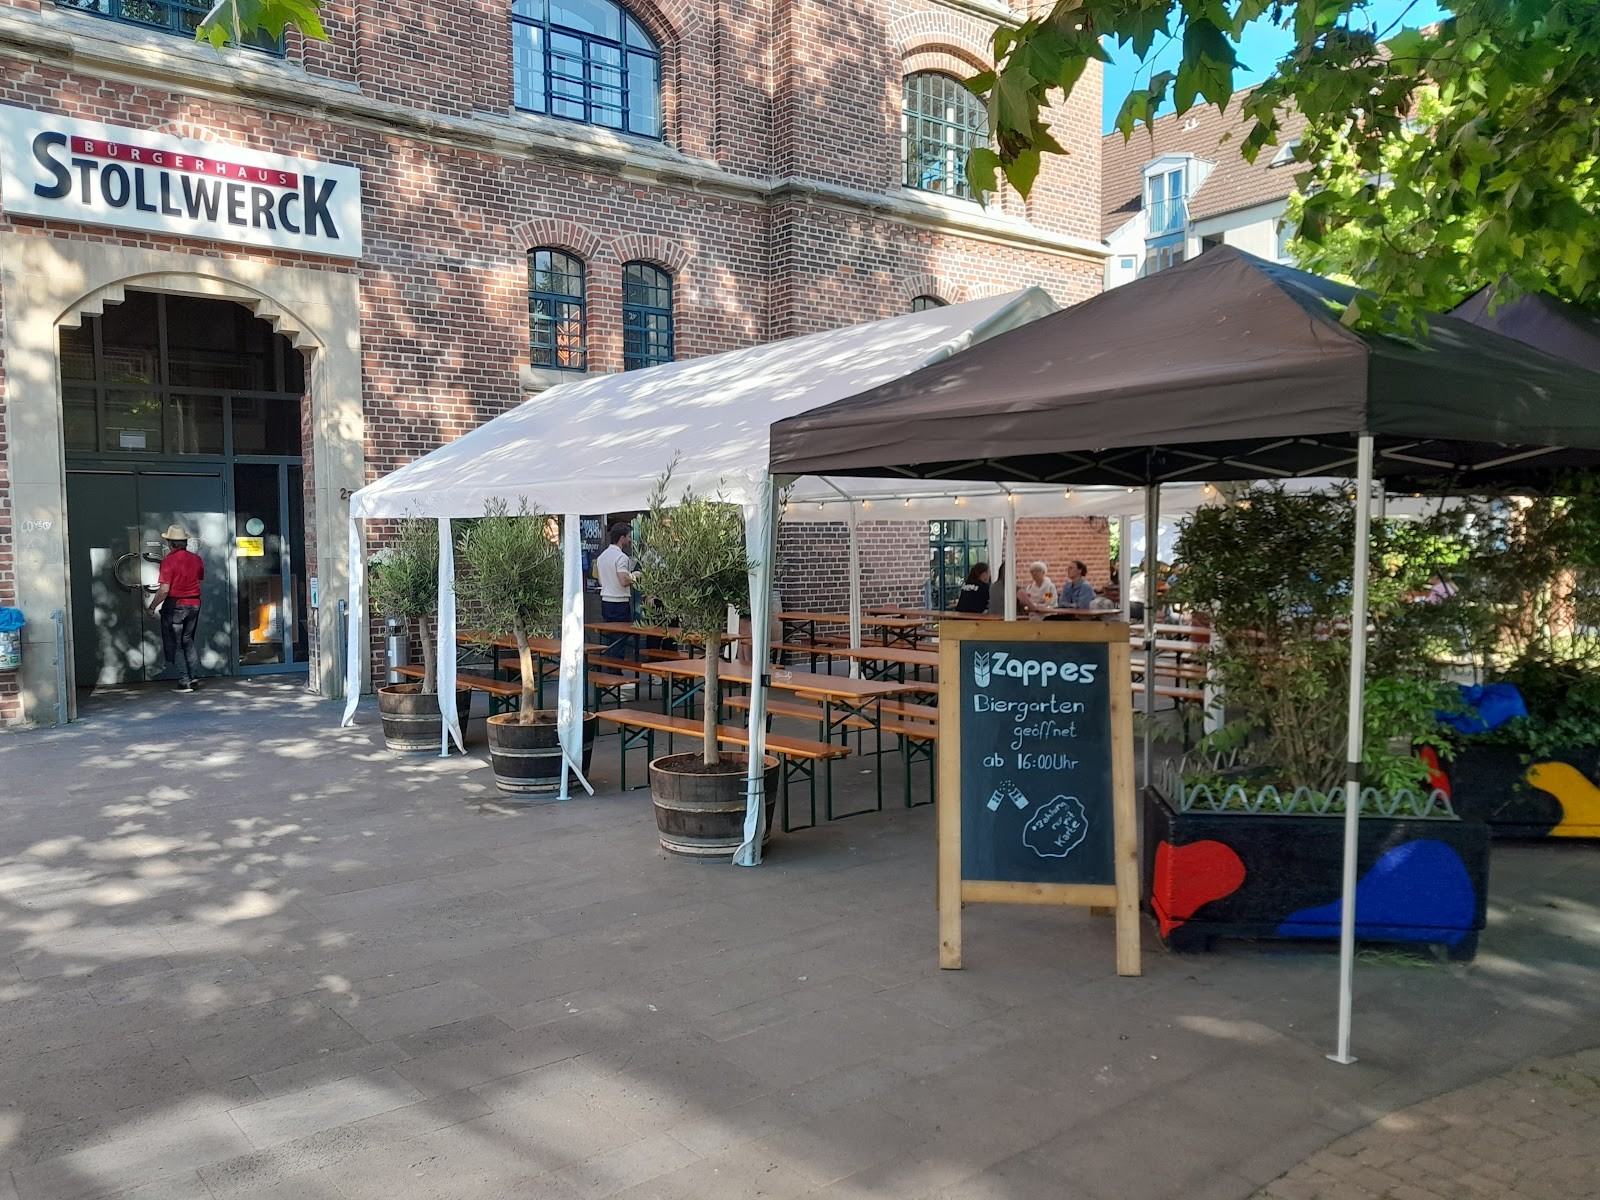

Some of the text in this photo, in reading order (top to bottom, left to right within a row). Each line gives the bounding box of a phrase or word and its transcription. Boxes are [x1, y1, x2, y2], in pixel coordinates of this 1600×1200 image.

[84, 139, 288, 186] BÜRGERHAUS
[32, 131, 340, 240] STOLLWERCK
[991, 652, 1098, 687] Zappes
[973, 694, 1085, 722] Biergarten
[1011, 720, 1077, 751] geöffnet
[983, 752, 1005, 768] ab
[1053, 820, 1080, 848] Karte
